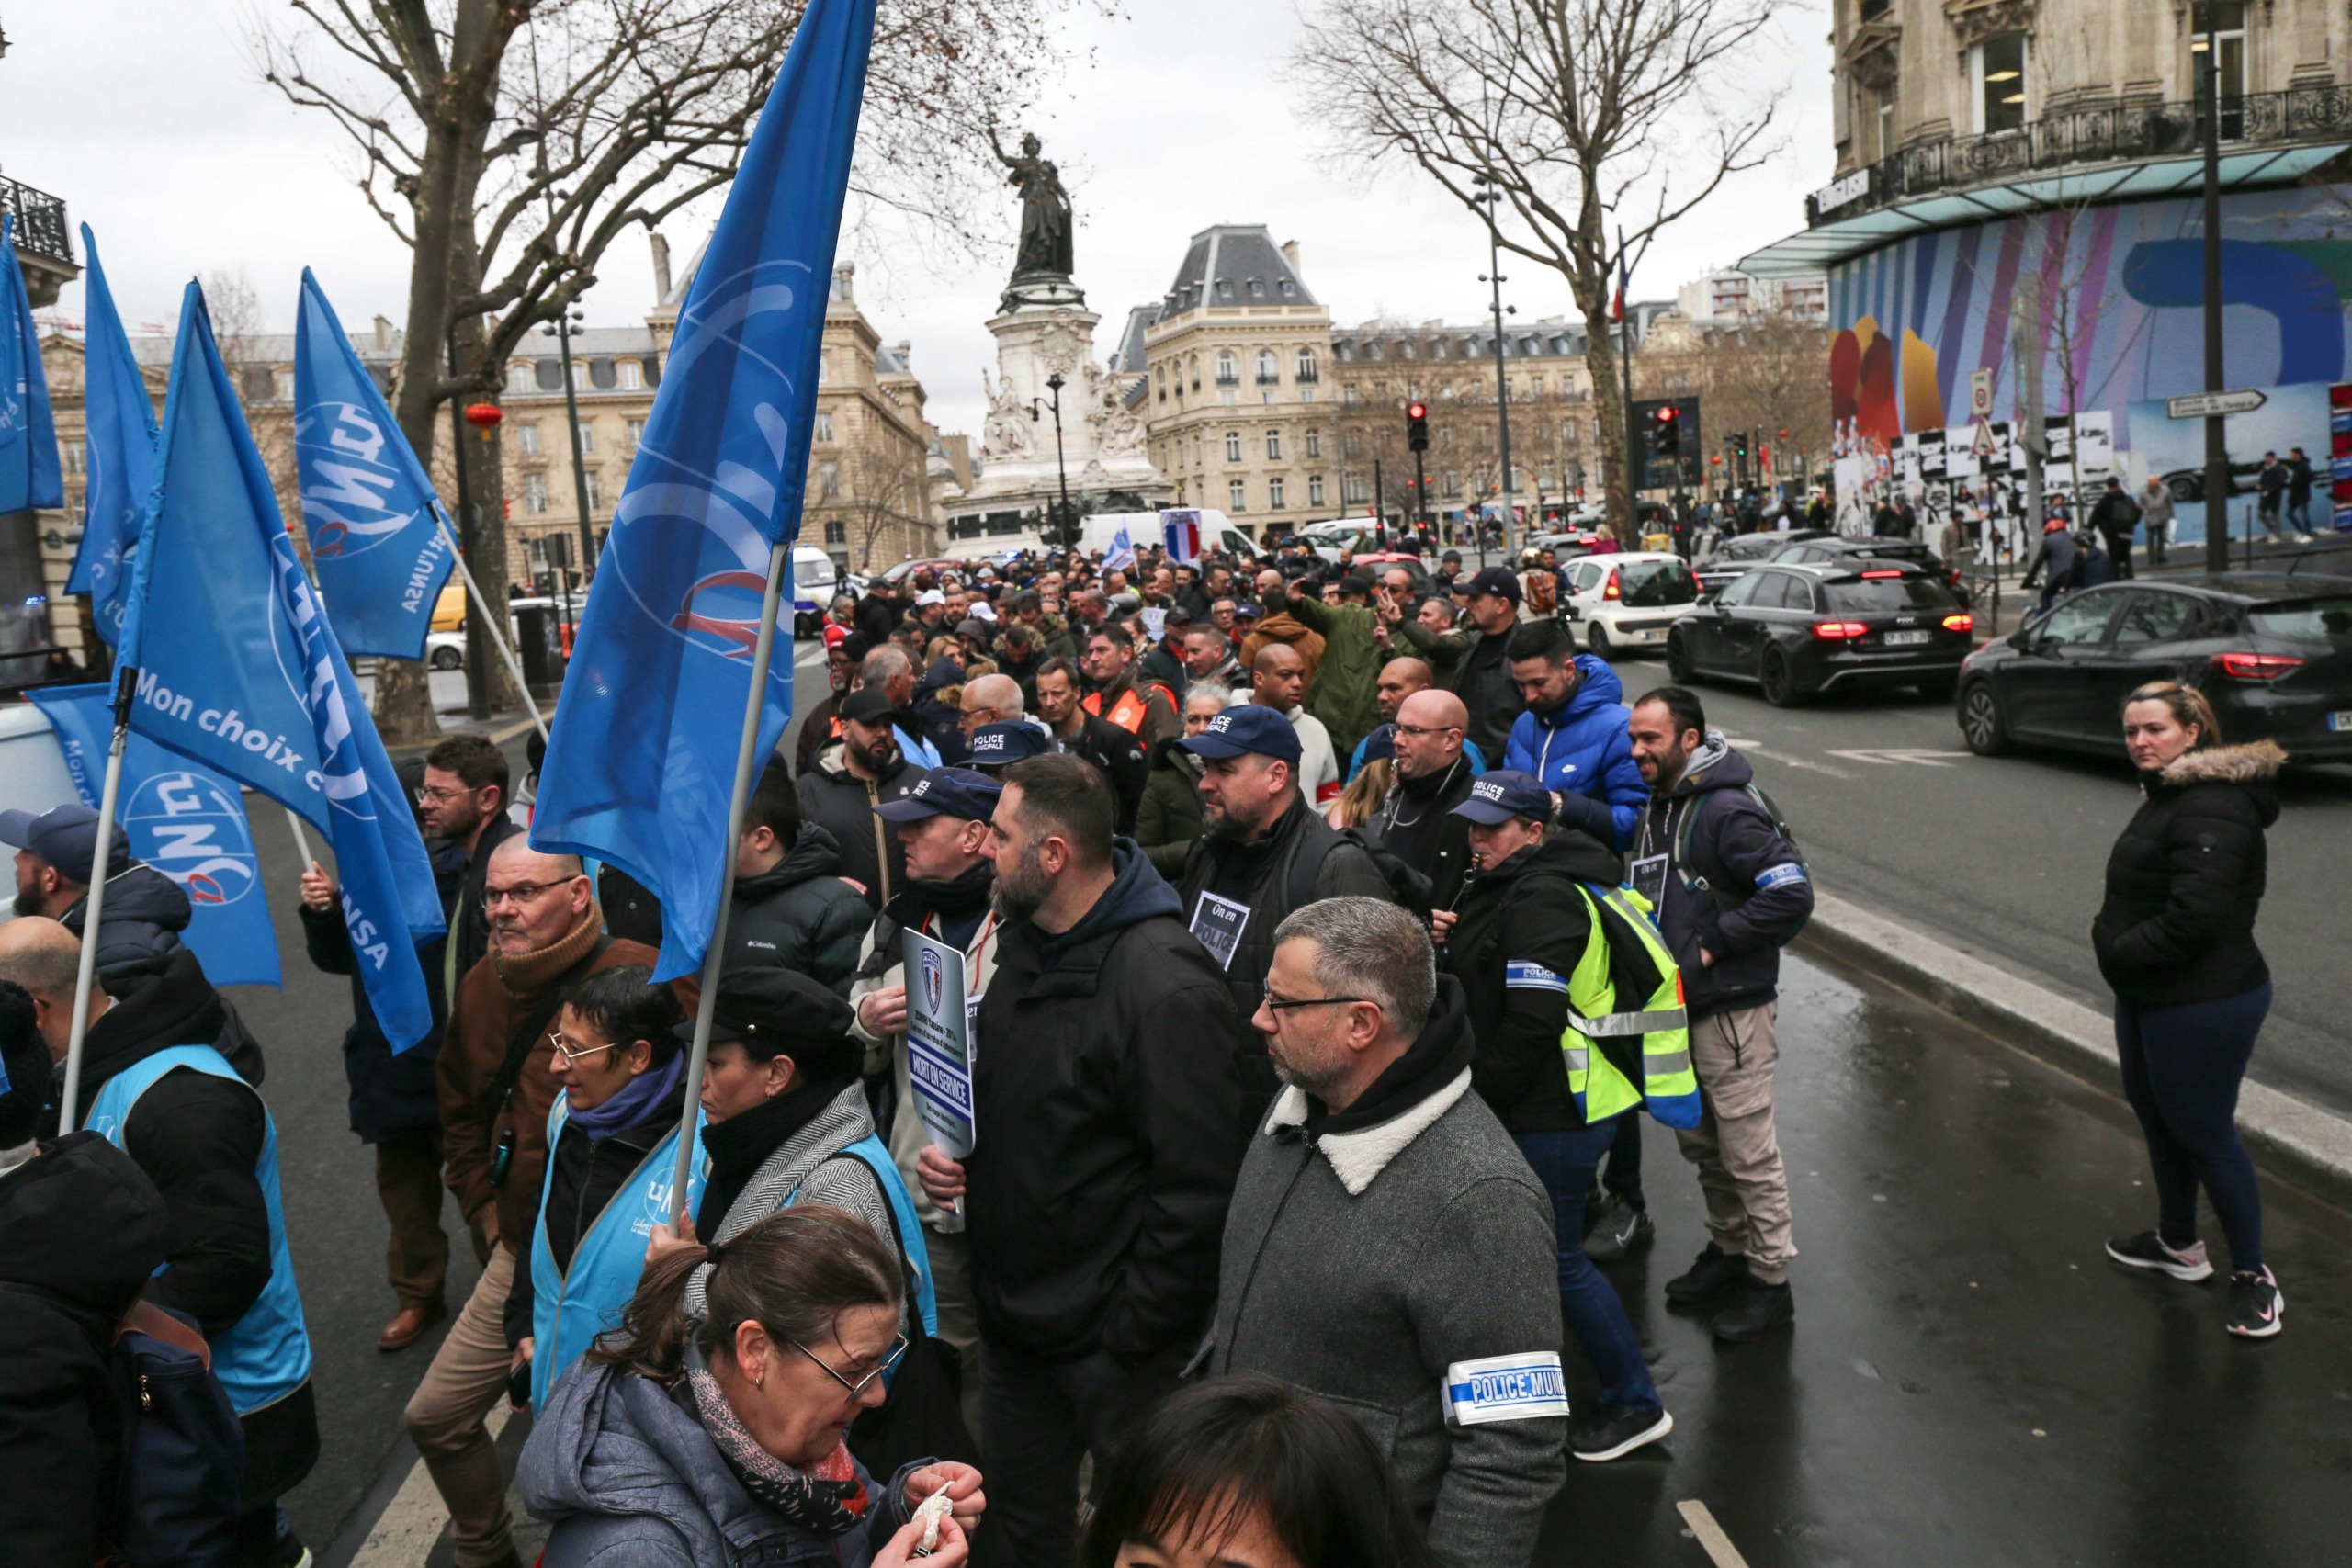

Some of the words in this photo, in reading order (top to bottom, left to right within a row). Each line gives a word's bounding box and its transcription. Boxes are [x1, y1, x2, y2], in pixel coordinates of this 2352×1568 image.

[135, 667, 194, 722] Mon
[198, 709, 304, 773] choix
[974, 734, 1004, 746] POLICE
[1473, 781, 1505, 795] POLICE
[1212, 903, 1226, 919] On
[1225, 910, 1237, 922] en
[912, 1053, 930, 1080] MORT
[930, 1064, 939, 1088] EN
[939, 1069, 967, 1104] SERVICE
[1471, 1372, 1528, 1404] POLICE
